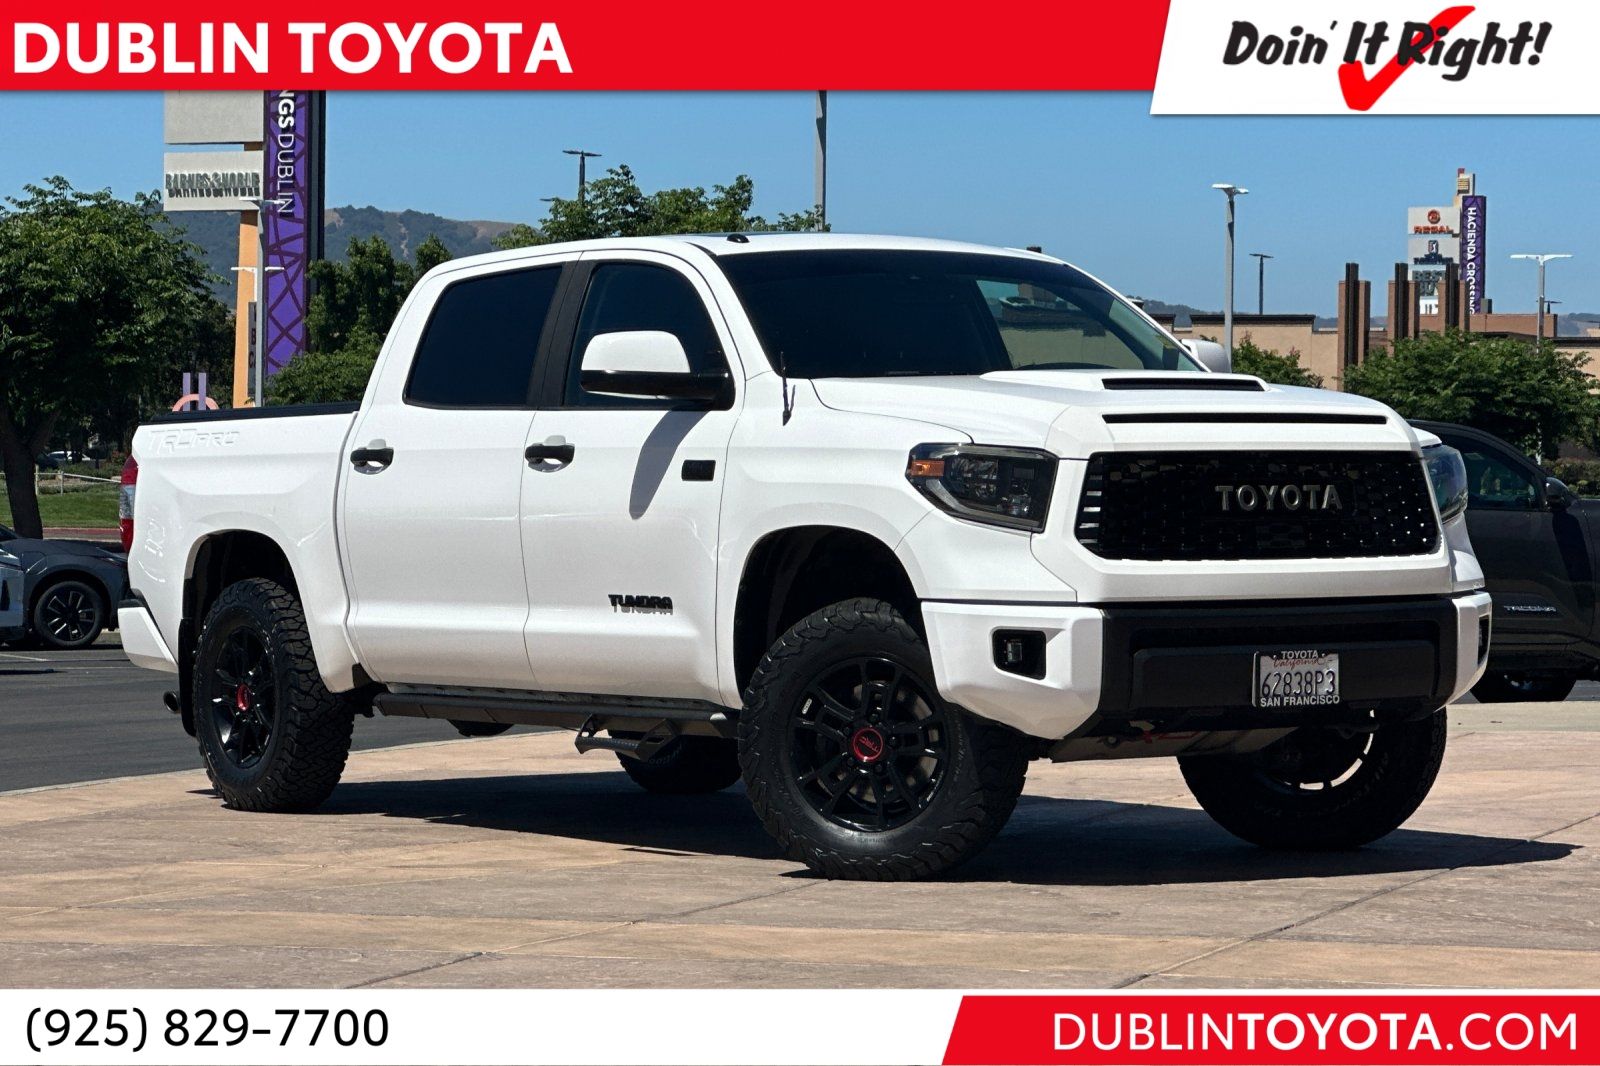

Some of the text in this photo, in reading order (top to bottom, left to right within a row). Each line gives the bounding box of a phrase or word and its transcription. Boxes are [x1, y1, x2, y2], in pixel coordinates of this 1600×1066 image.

[277, 133, 294, 213] DUBLIN
[1467, 207, 1477, 260] HACIENDA
[1215, 484, 1342, 511] TOYOTA
[608, 594, 673, 610] TUNDRA
[1281, 650, 1318, 659] TOYOTA
[1262, 670, 1335, 698] 62838P3
[1260, 695, 1340, 708] SAN FRANCISCO
